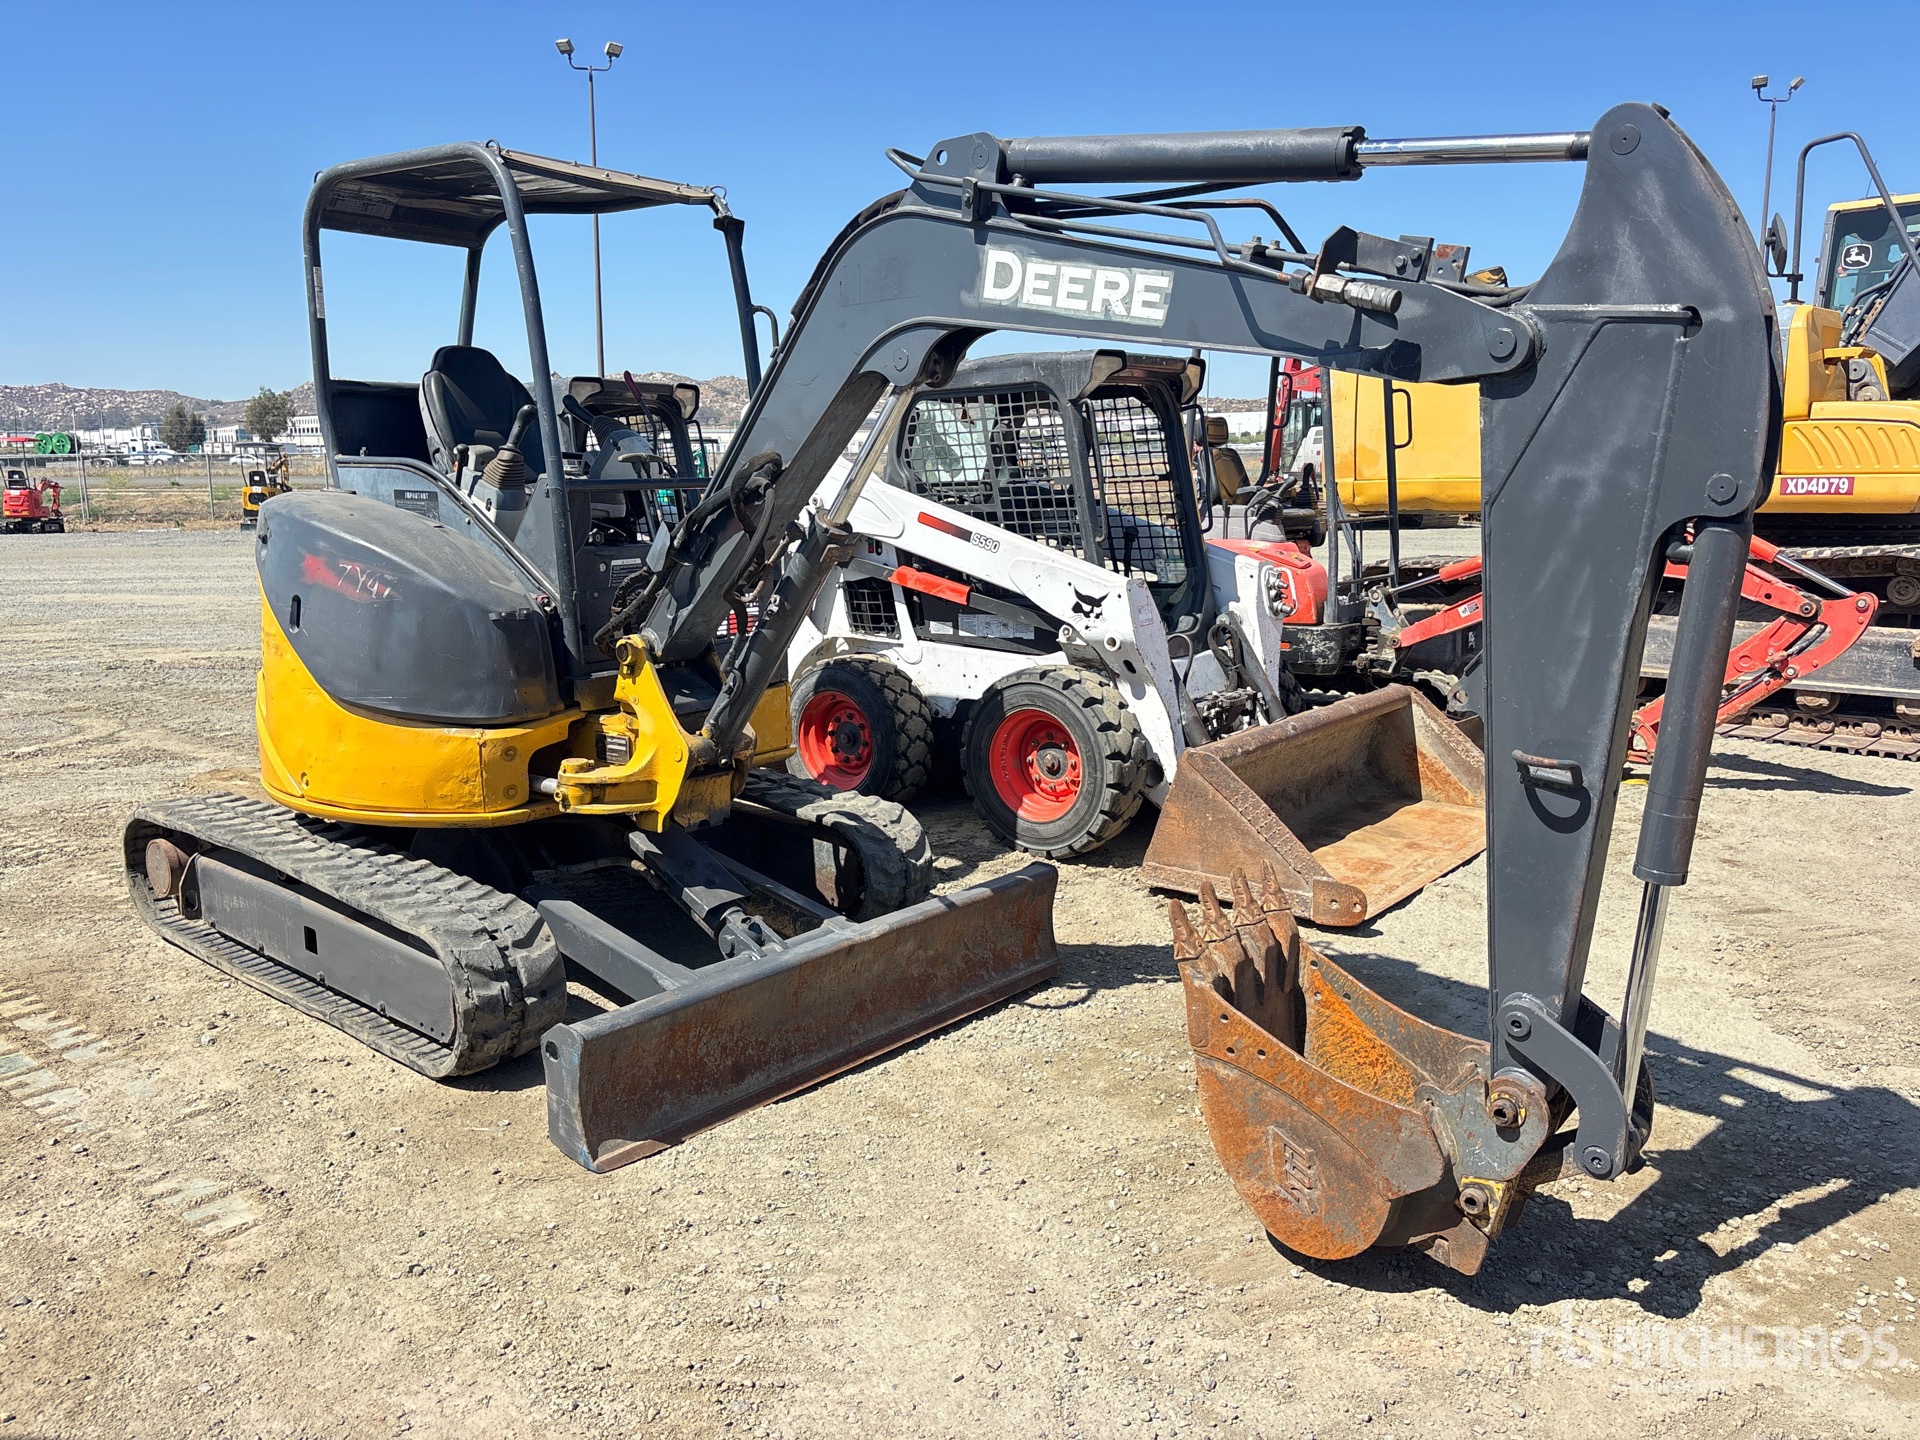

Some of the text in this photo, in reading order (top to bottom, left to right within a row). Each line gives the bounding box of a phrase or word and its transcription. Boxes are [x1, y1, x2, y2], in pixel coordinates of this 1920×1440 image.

[983, 249, 1170, 320] DEERE
[1785, 478, 1849, 494] XD4D79
[972, 533, 1001, 554] S590
